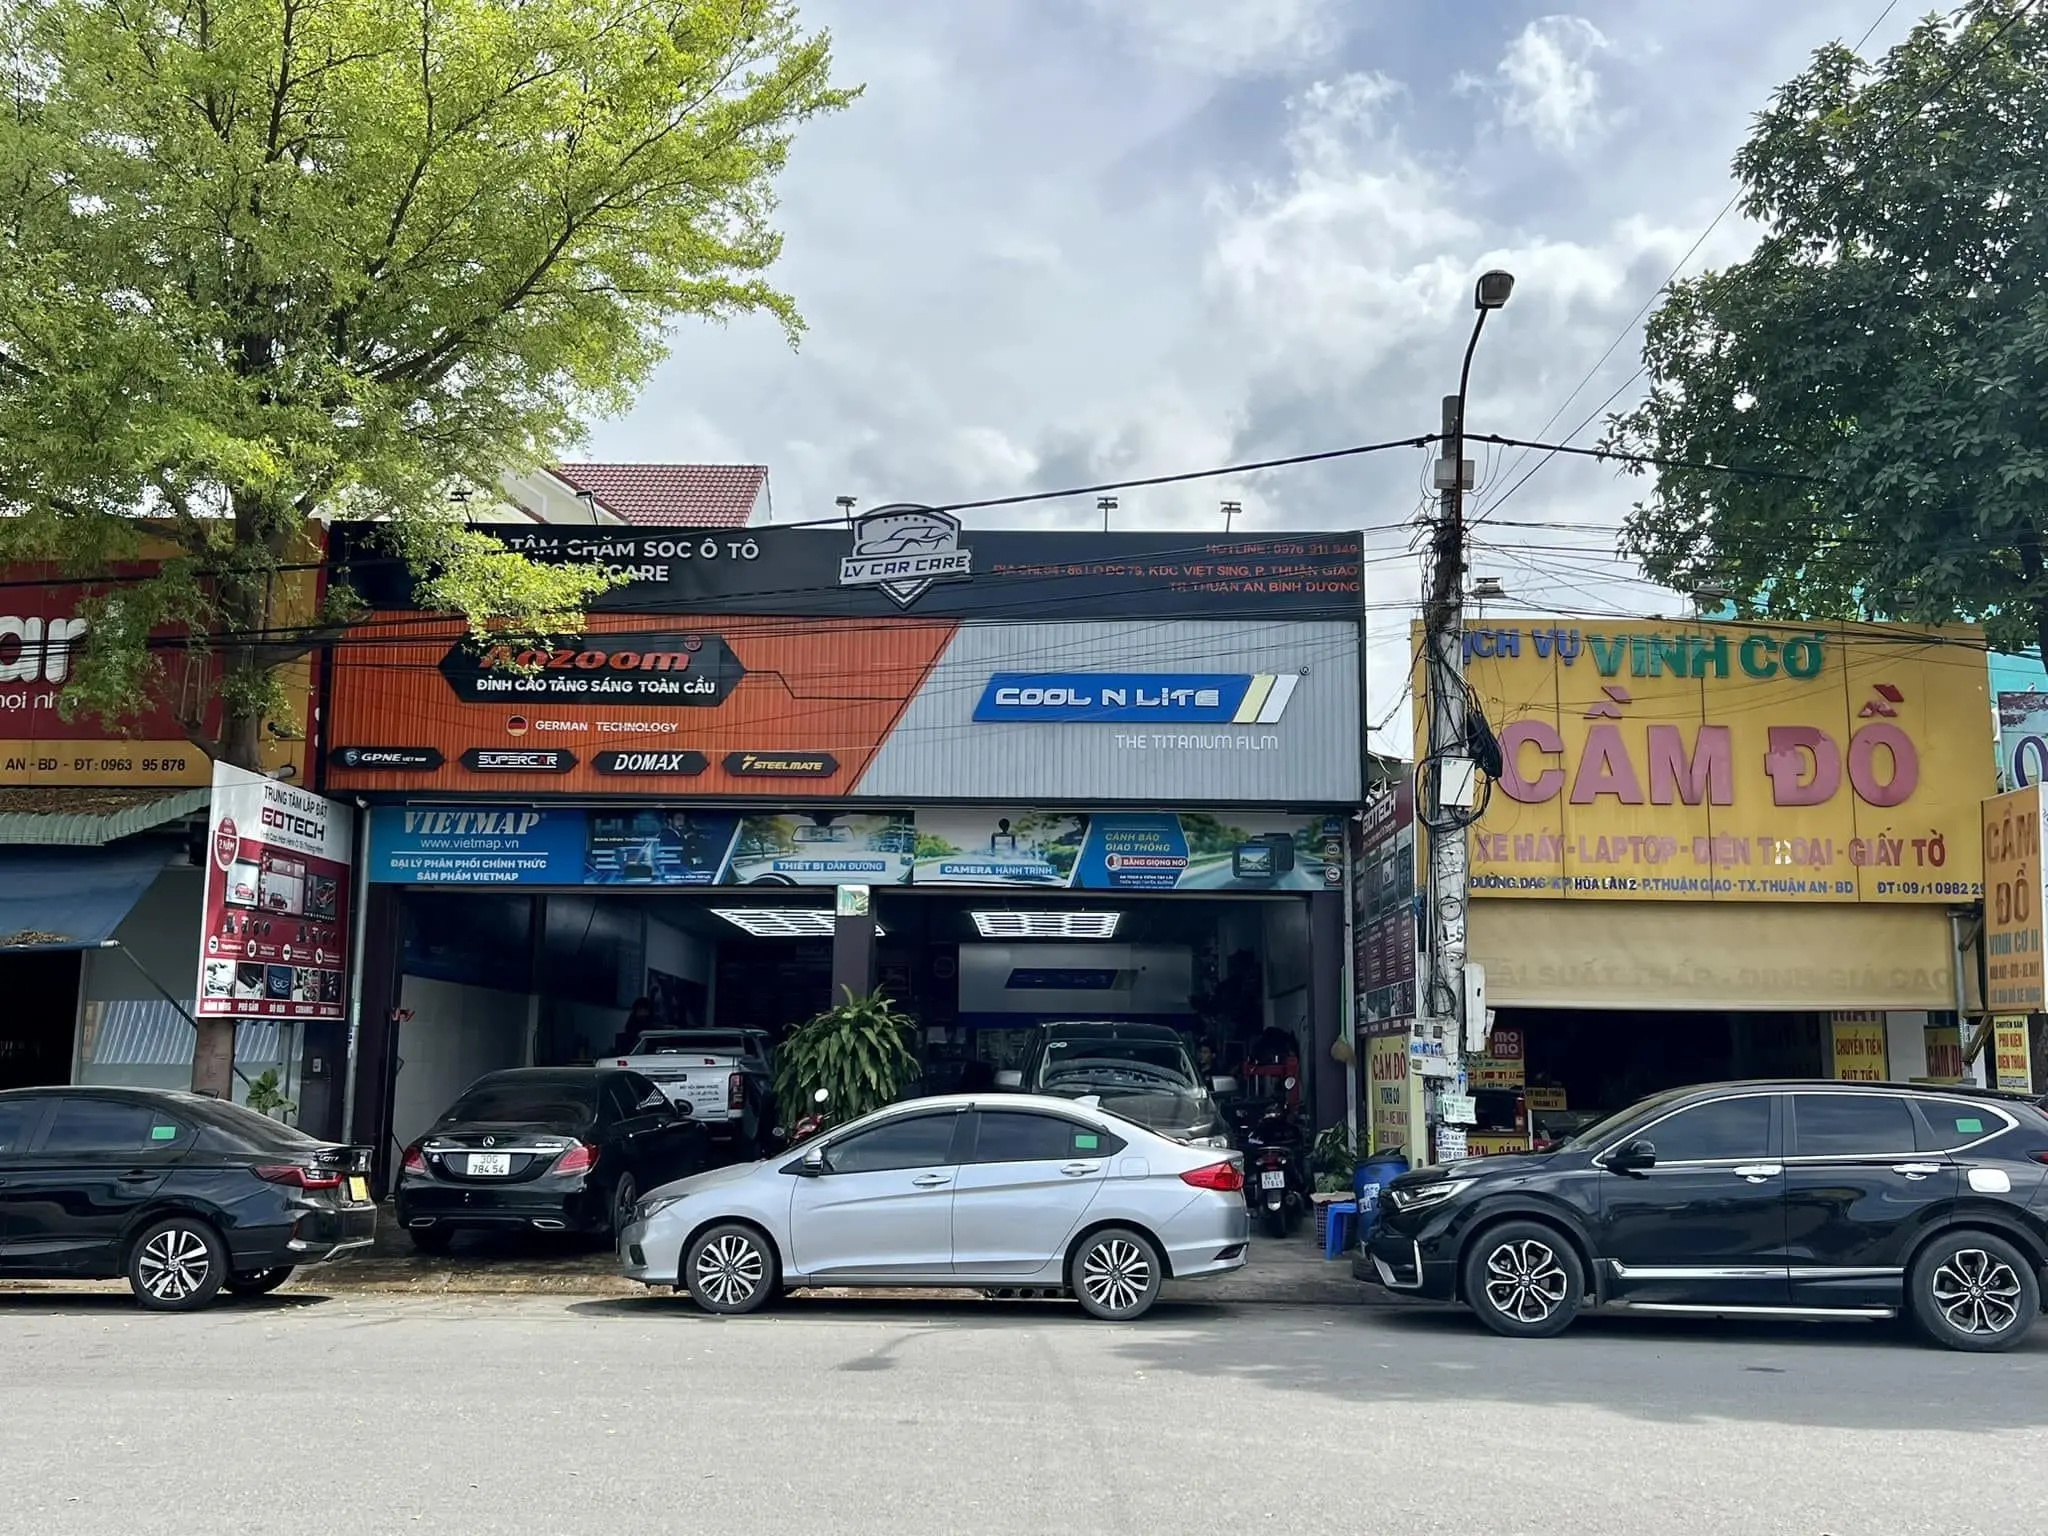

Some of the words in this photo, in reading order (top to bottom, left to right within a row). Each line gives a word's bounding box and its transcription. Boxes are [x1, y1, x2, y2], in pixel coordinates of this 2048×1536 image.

[643, 541, 692, 558] SOC
[700, 538, 718, 559] Ô
[727, 538, 760, 560] TÔ
[844, 565, 866, 578] LV
[870, 561, 911, 576] CAR
[915, 556, 968, 571] CARE
[1149, 565, 1179, 577] KDC
[1269, 579, 1301, 593] BÌNH
[1305, 582, 1361, 593] DƯƠNG
[1532, 628, 1581, 666] VỤ
[548, 675, 588, 692] TĂNG
[590, 676, 633, 693] SÁNG
[638, 678, 680, 694] TOÀN
[683, 675, 716, 695] CẦU
[995, 687, 1092, 706] COOL
[1101, 687, 1127, 706] N
[535, 720, 588, 731] GERMAN
[595, 721, 679, 733] TECHNOLOGY
[1115, 734, 1147, 750] THE
[1152, 735, 1232, 750] TITANIUM
[1237, 735, 1279, 751] FILM
[1496, 686, 1734, 806] CẦM
[1764, 686, 1919, 807] ĐỒ
[361, 752, 402, 762] GPNE
[477, 754, 558, 766] SUPERCAR
[613, 753, 684, 771] DOMAX
[5, 758, 26, 771] AN
[38, 758, 58, 771] BD
[752, 760, 823, 770] STEELMATE
[404, 811, 540, 835] VIETMAP
[420, 838, 519, 850] www.vietmap.vn
[1475, 833, 1509, 862] XE
[1513, 827, 1566, 863] MÁY
[1579, 834, 1678, 865] LAPTOP
[1848, 827, 1905, 867] GIẤY
[1911, 829, 1947, 868] TỜ
[481, 857, 516, 869] CHÍNH
[944, 865, 992, 875] CAMERA
[472, 872, 519, 881] VIETMAP
